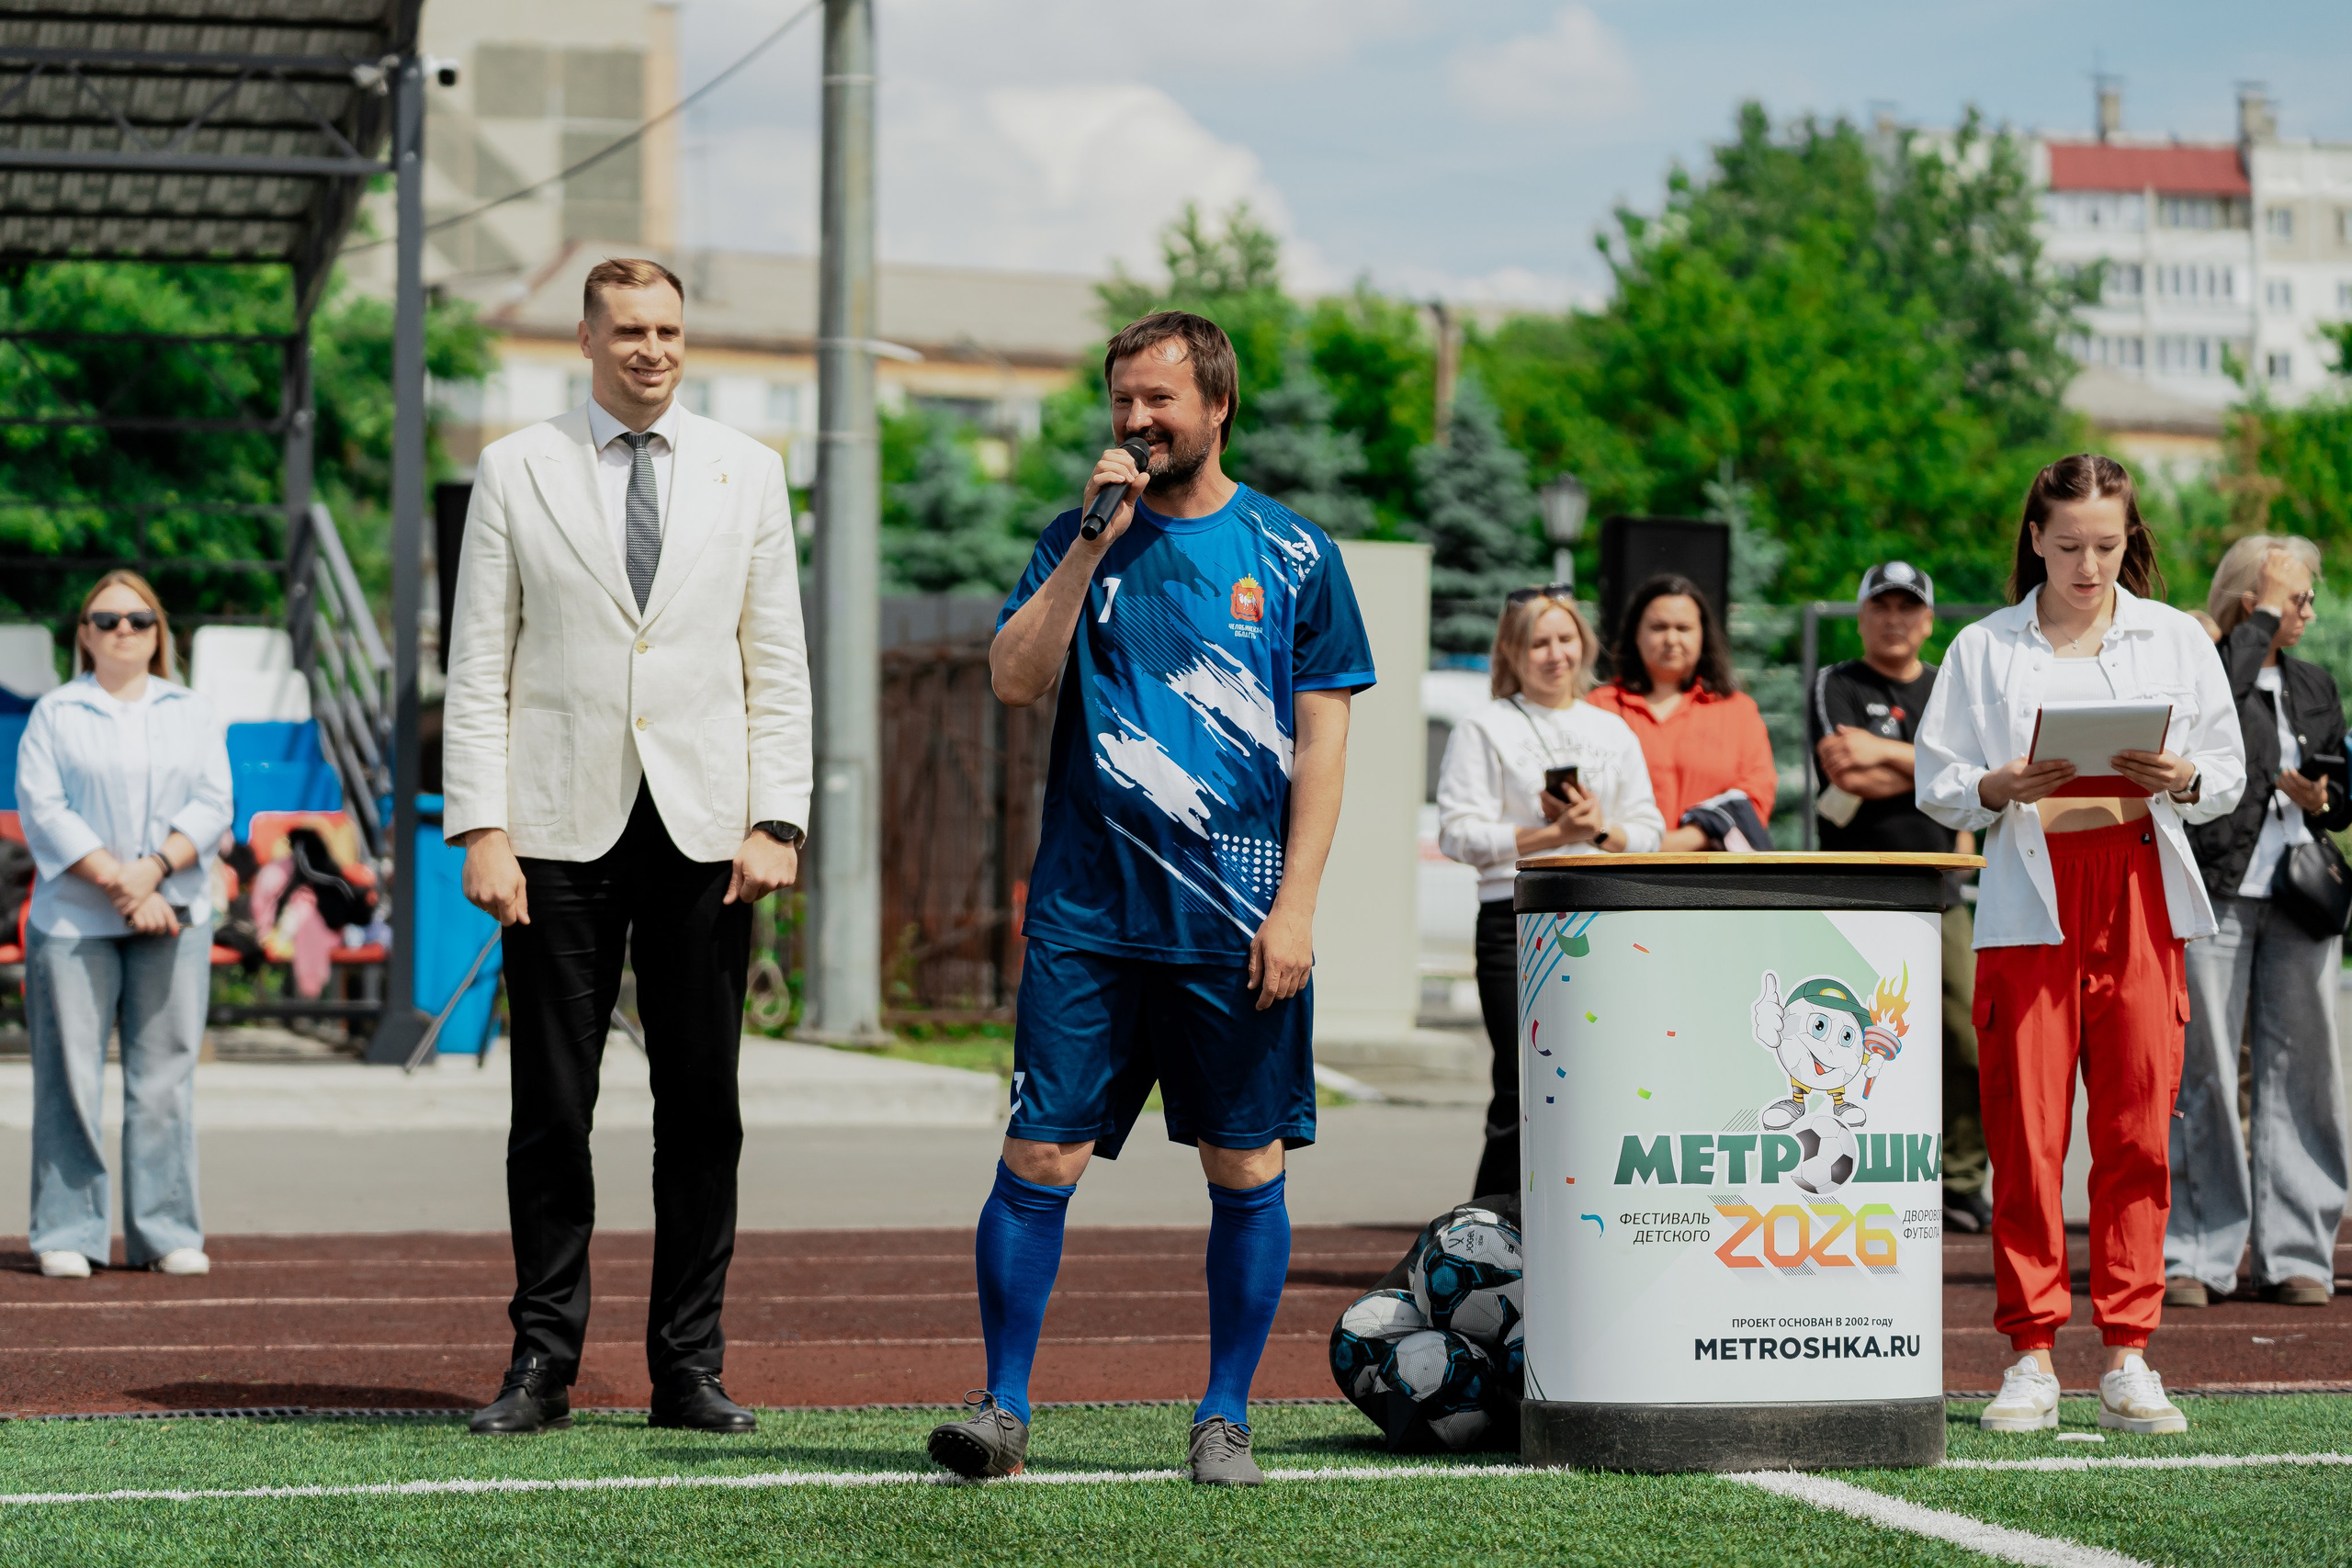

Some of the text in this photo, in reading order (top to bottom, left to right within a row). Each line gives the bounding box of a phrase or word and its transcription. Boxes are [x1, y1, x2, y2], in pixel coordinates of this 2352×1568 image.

[1098, 577, 1122, 623] 7
[1620, 1213, 1711, 1224] ФЕСТИВАЛЬ
[1633, 1229, 1711, 1245] ДЕТСКОГО
[1713, 1203, 1897, 1269] 2026
[1903, 1227, 1939, 1239] ФУТБОЛА
[1732, 1316, 1894, 1328] ПРОЕКТ ОСНОВАН В 2002 году
[1694, 1335, 1920, 1360] METROSHKA.RU
